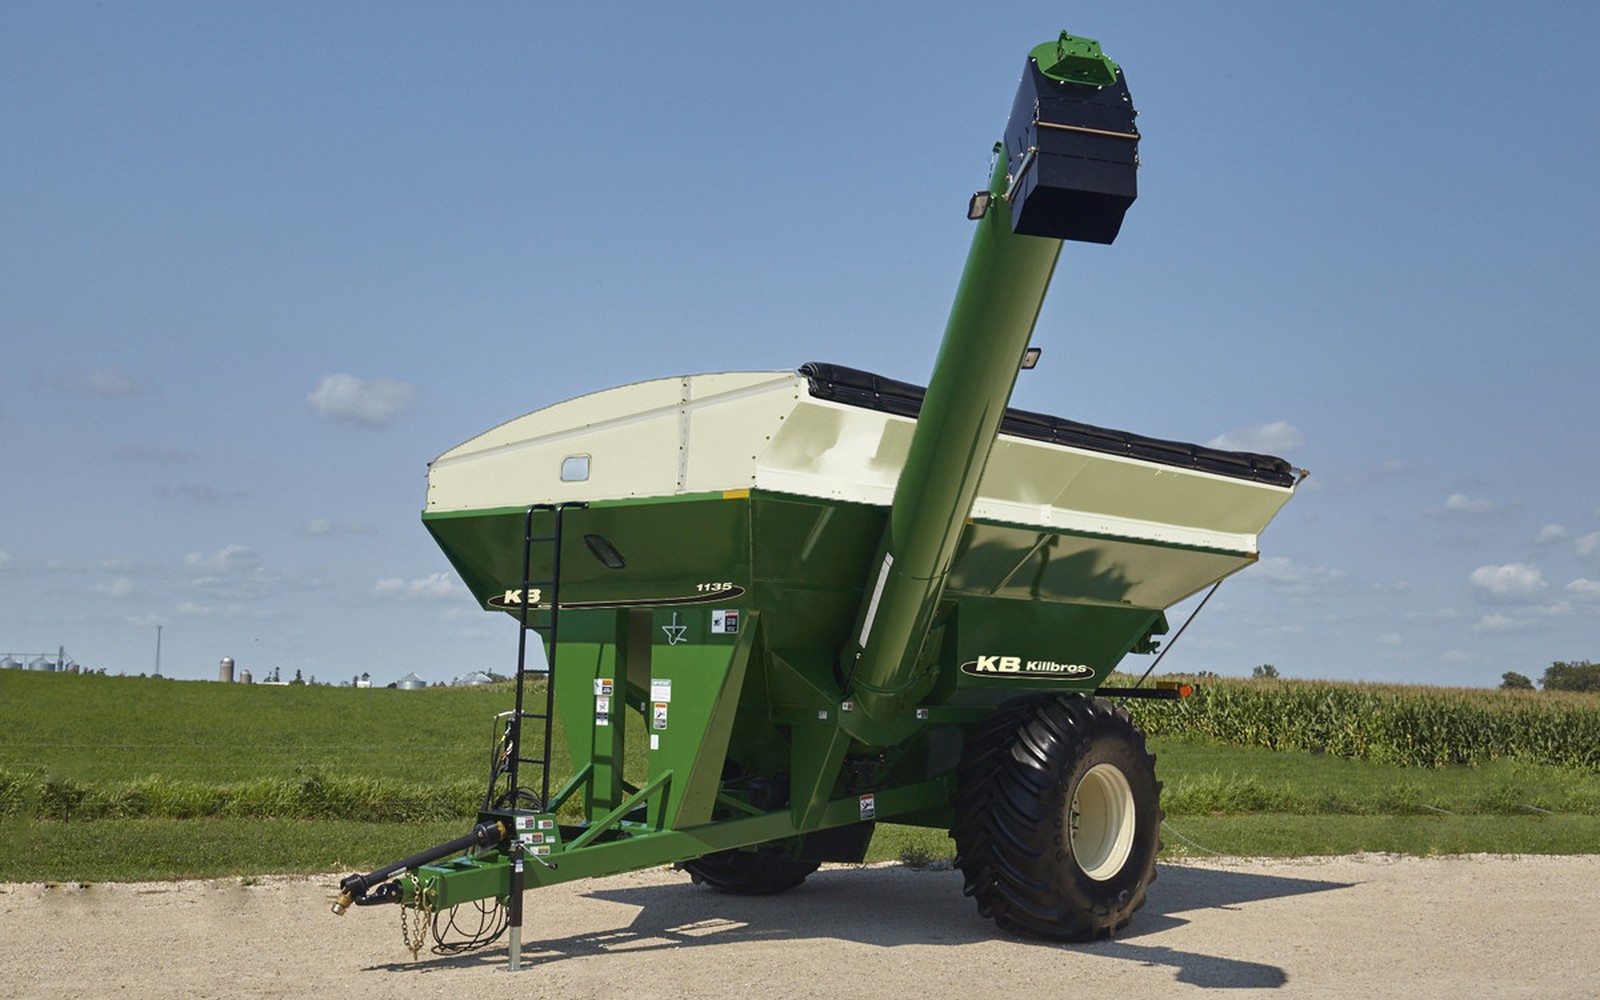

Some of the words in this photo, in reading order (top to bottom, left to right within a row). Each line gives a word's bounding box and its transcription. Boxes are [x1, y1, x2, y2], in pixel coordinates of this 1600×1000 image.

[696, 582, 733, 592] 1135
[976, 656, 1021, 673] KB
[1026, 661, 1088, 673] Killbros
